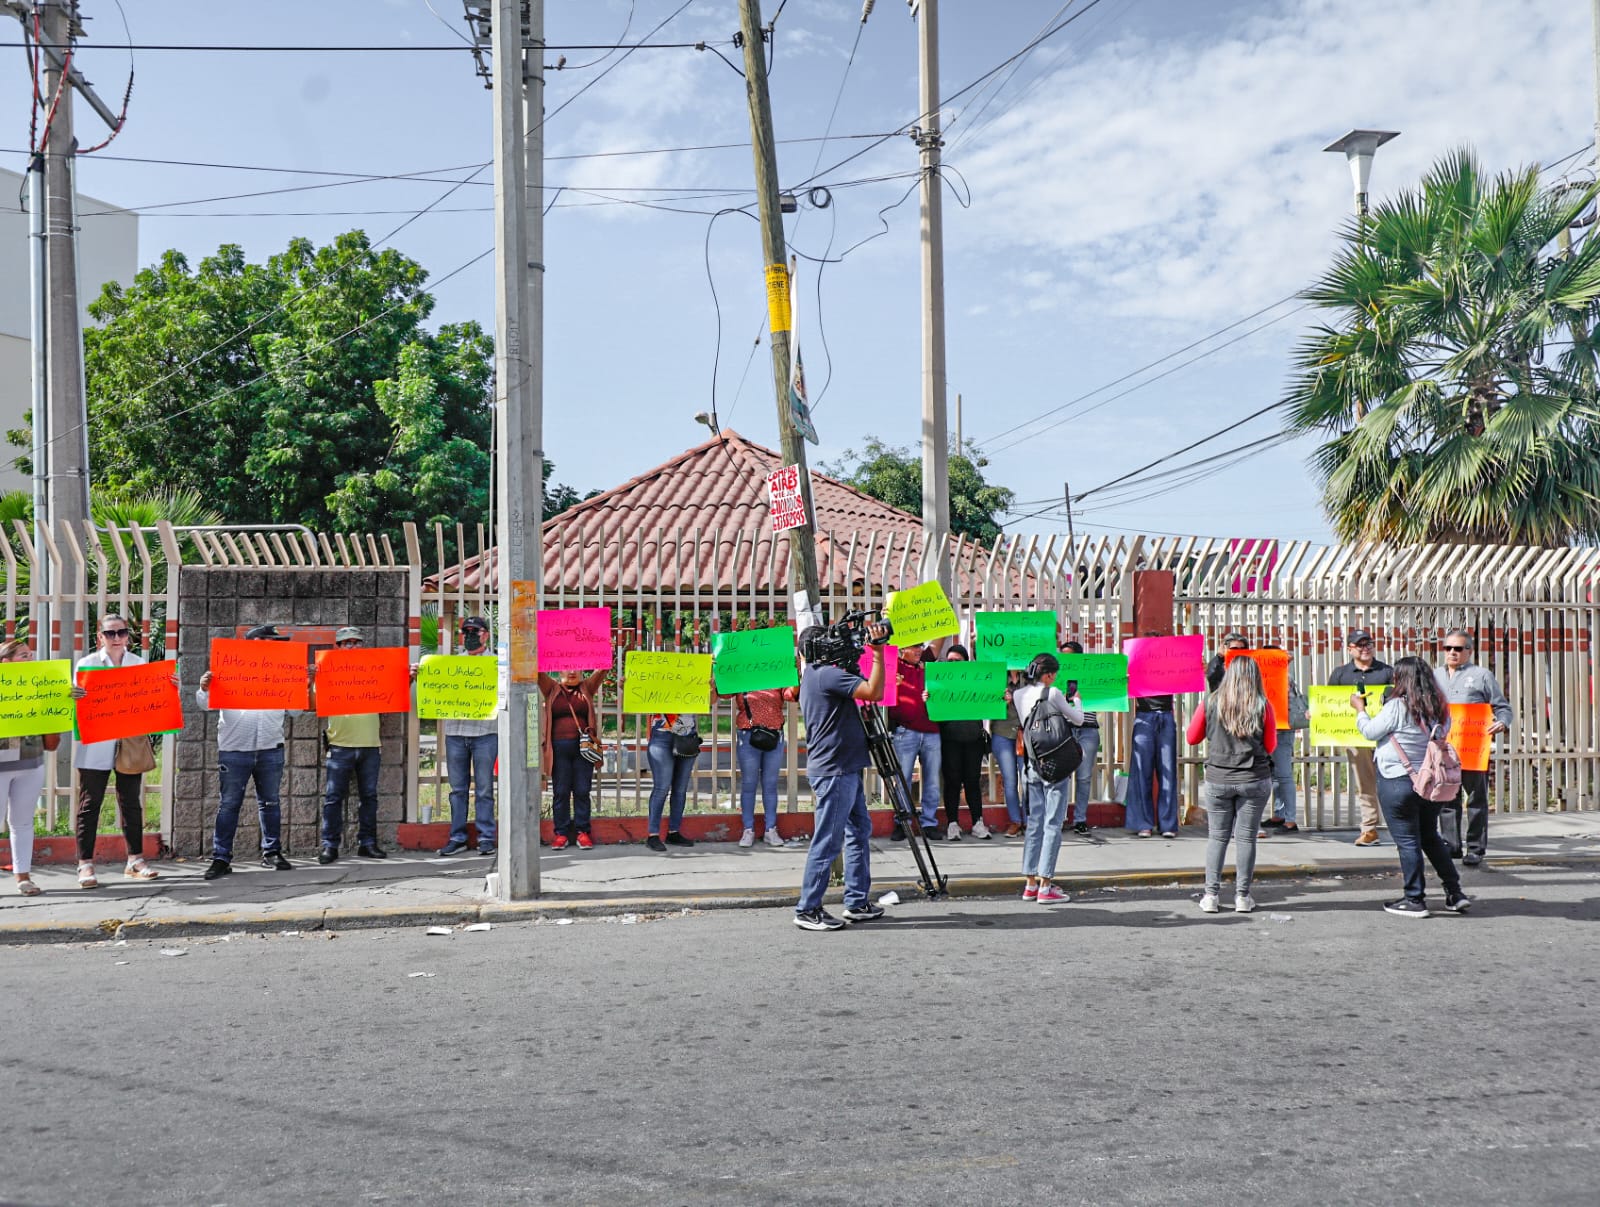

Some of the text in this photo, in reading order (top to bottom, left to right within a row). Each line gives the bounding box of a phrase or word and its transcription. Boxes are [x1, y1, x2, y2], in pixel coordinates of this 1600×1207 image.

[767, 466, 796, 482] COMPRO
[771, 474, 798, 492] AIRES
[751, 634, 770, 647] AL
[982, 632, 1006, 649] NO
[630, 653, 695, 669] FUERA LA
[17, 674, 27, 687] de
[31, 675, 68, 688] Gobierno
[628, 670, 682, 682] MENTIRA
[935, 672, 954, 681] NO
[26, 707, 37, 718] de
[1321, 710, 1354, 719] volunta
